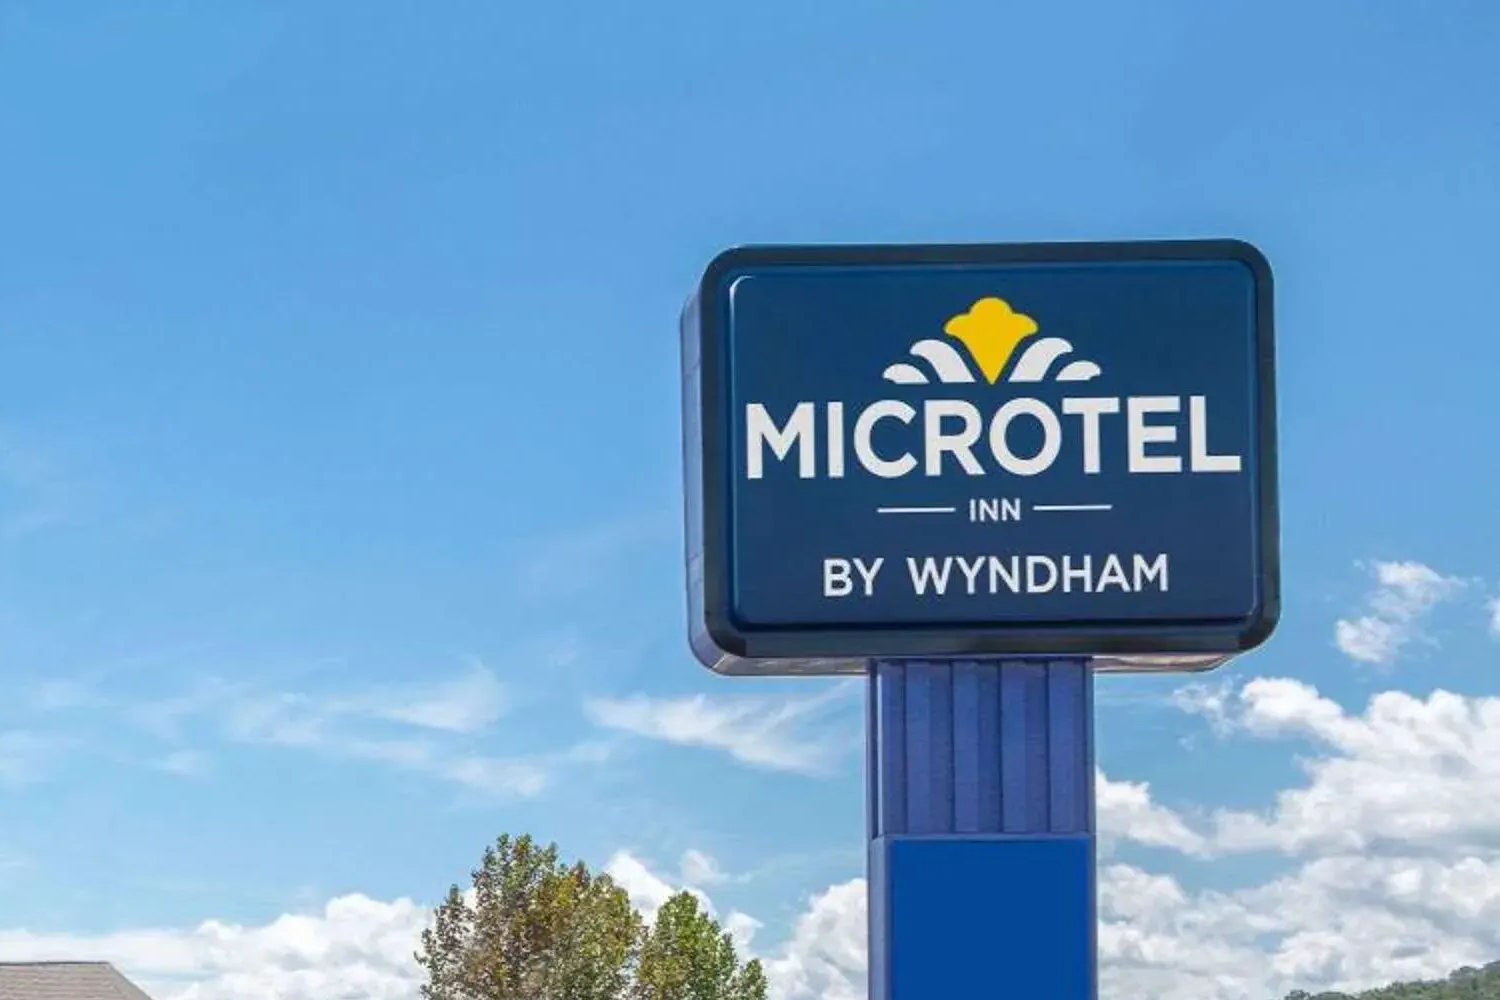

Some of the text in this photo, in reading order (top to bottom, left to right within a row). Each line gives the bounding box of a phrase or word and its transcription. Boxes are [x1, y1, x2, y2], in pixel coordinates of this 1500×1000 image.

[746, 396, 1242, 479] MICROTEL
[970, 498, 1021, 522] INN
[823, 553, 1169, 597] BY WYNDHAM
